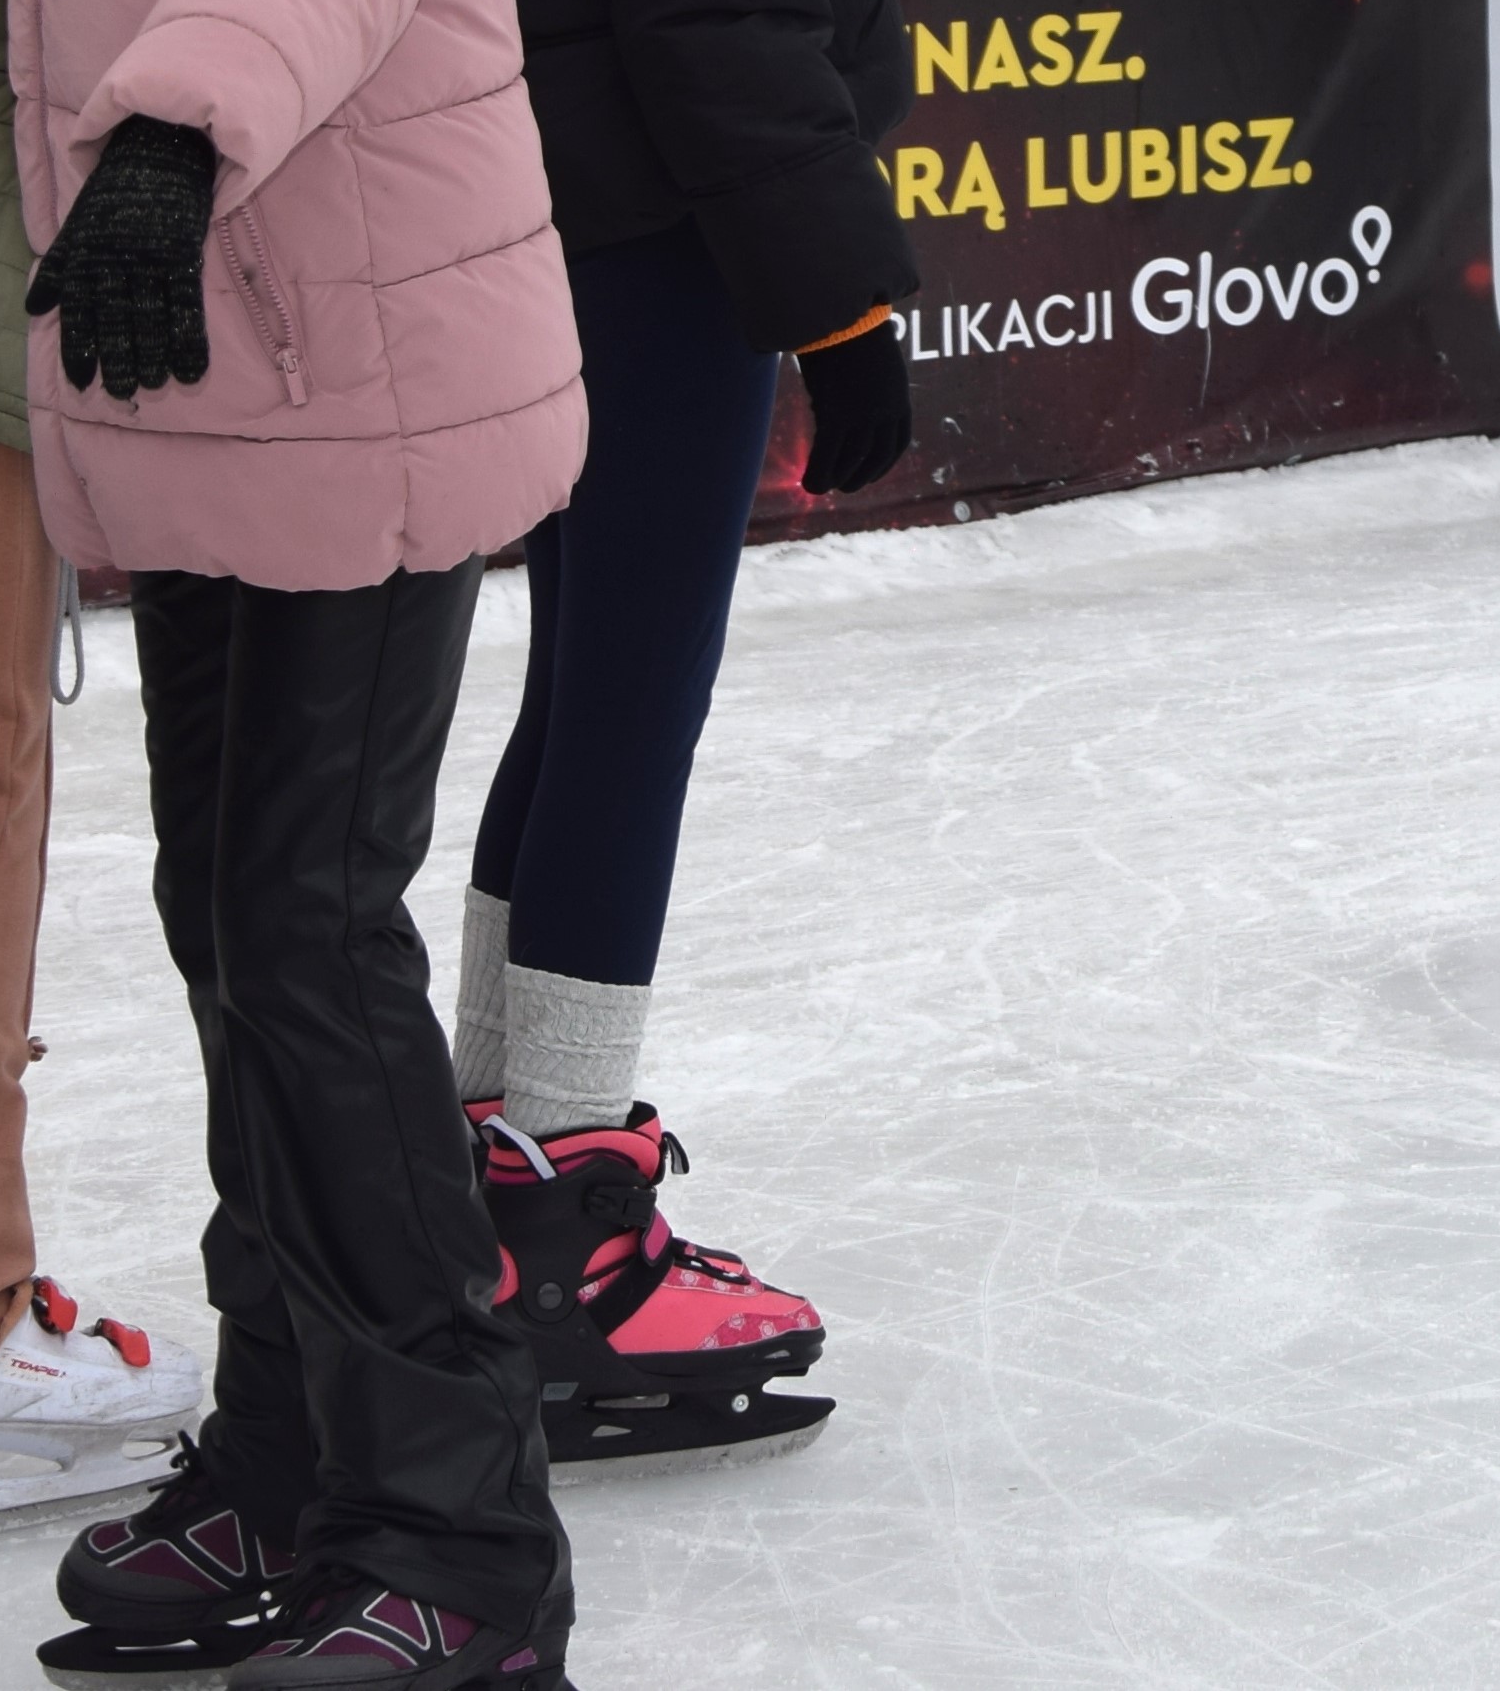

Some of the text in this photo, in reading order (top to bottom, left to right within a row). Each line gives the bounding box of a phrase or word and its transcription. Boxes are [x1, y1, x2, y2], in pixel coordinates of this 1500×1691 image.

[905, 11, 1146, 95] NASZ.
[876, 117, 1313, 232] RĄ LUBISZ.
[1130, 250, 1361, 335] Glovo
